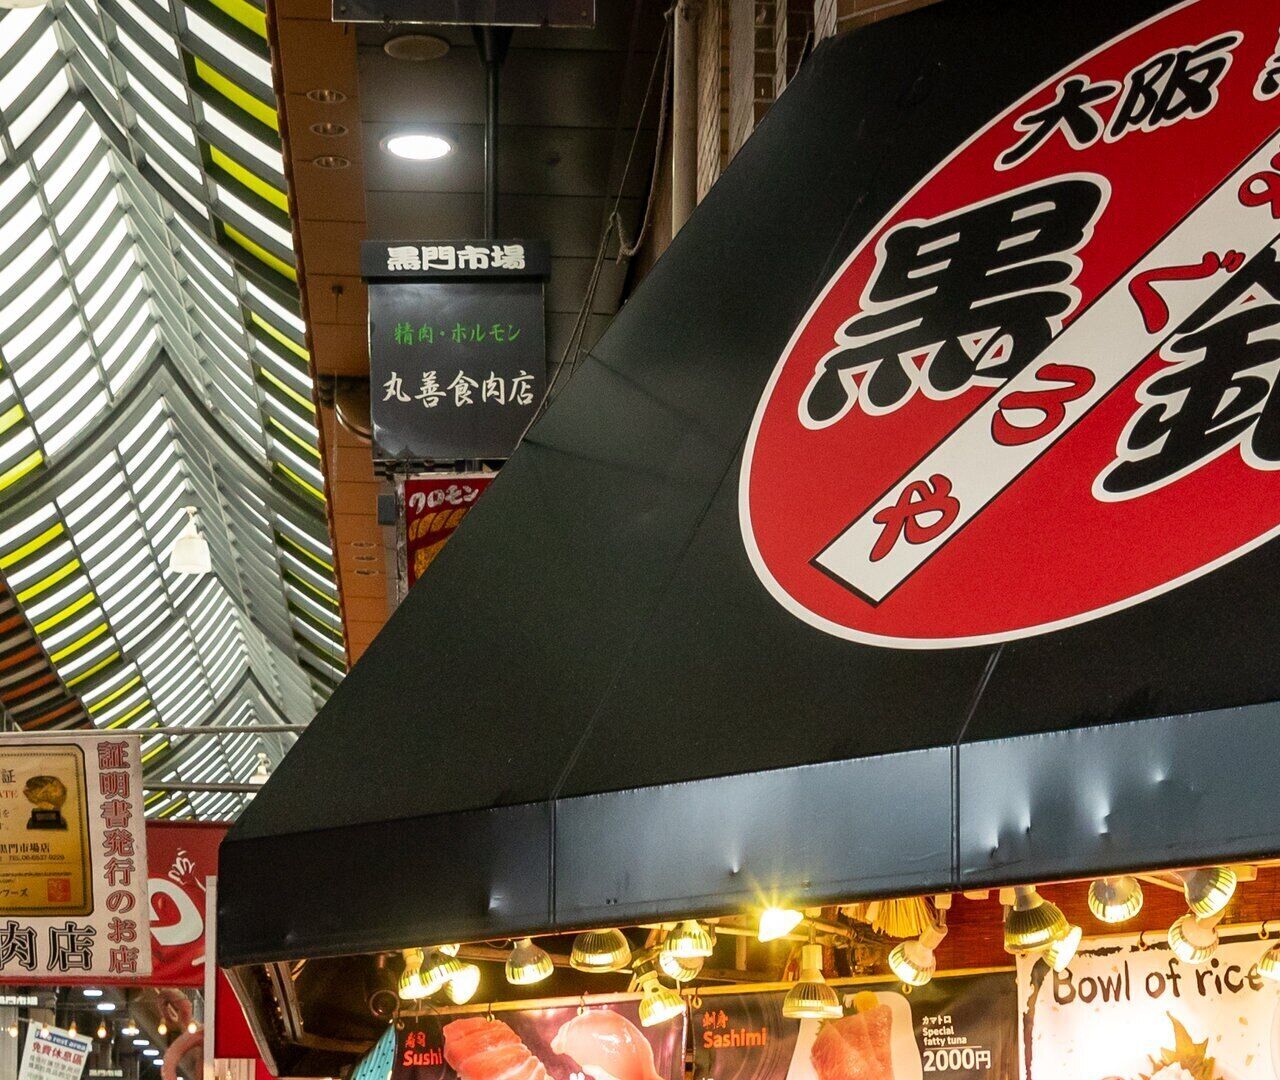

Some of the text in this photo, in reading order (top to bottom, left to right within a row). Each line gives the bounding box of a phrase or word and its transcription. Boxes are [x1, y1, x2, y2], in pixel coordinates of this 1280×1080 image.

[387, 245, 526, 271] 黒門市場
[382, 369, 535, 408] 丸善食肉店
[409, 485, 479, 516] クロモン
[97, 741, 140, 974] 証明書発行のお店
[1053, 958, 1265, 1005] Bowl of rice
[922, 1015, 952, 1026] カマトロ
[703, 1027, 767, 1049] Sashimi
[922, 1026, 954, 1039] Special
[923, 1035, 967, 1047] fatty tuna
[403, 1047, 443, 1066] Sushi
[923, 1049, 991, 1072] 2000円
